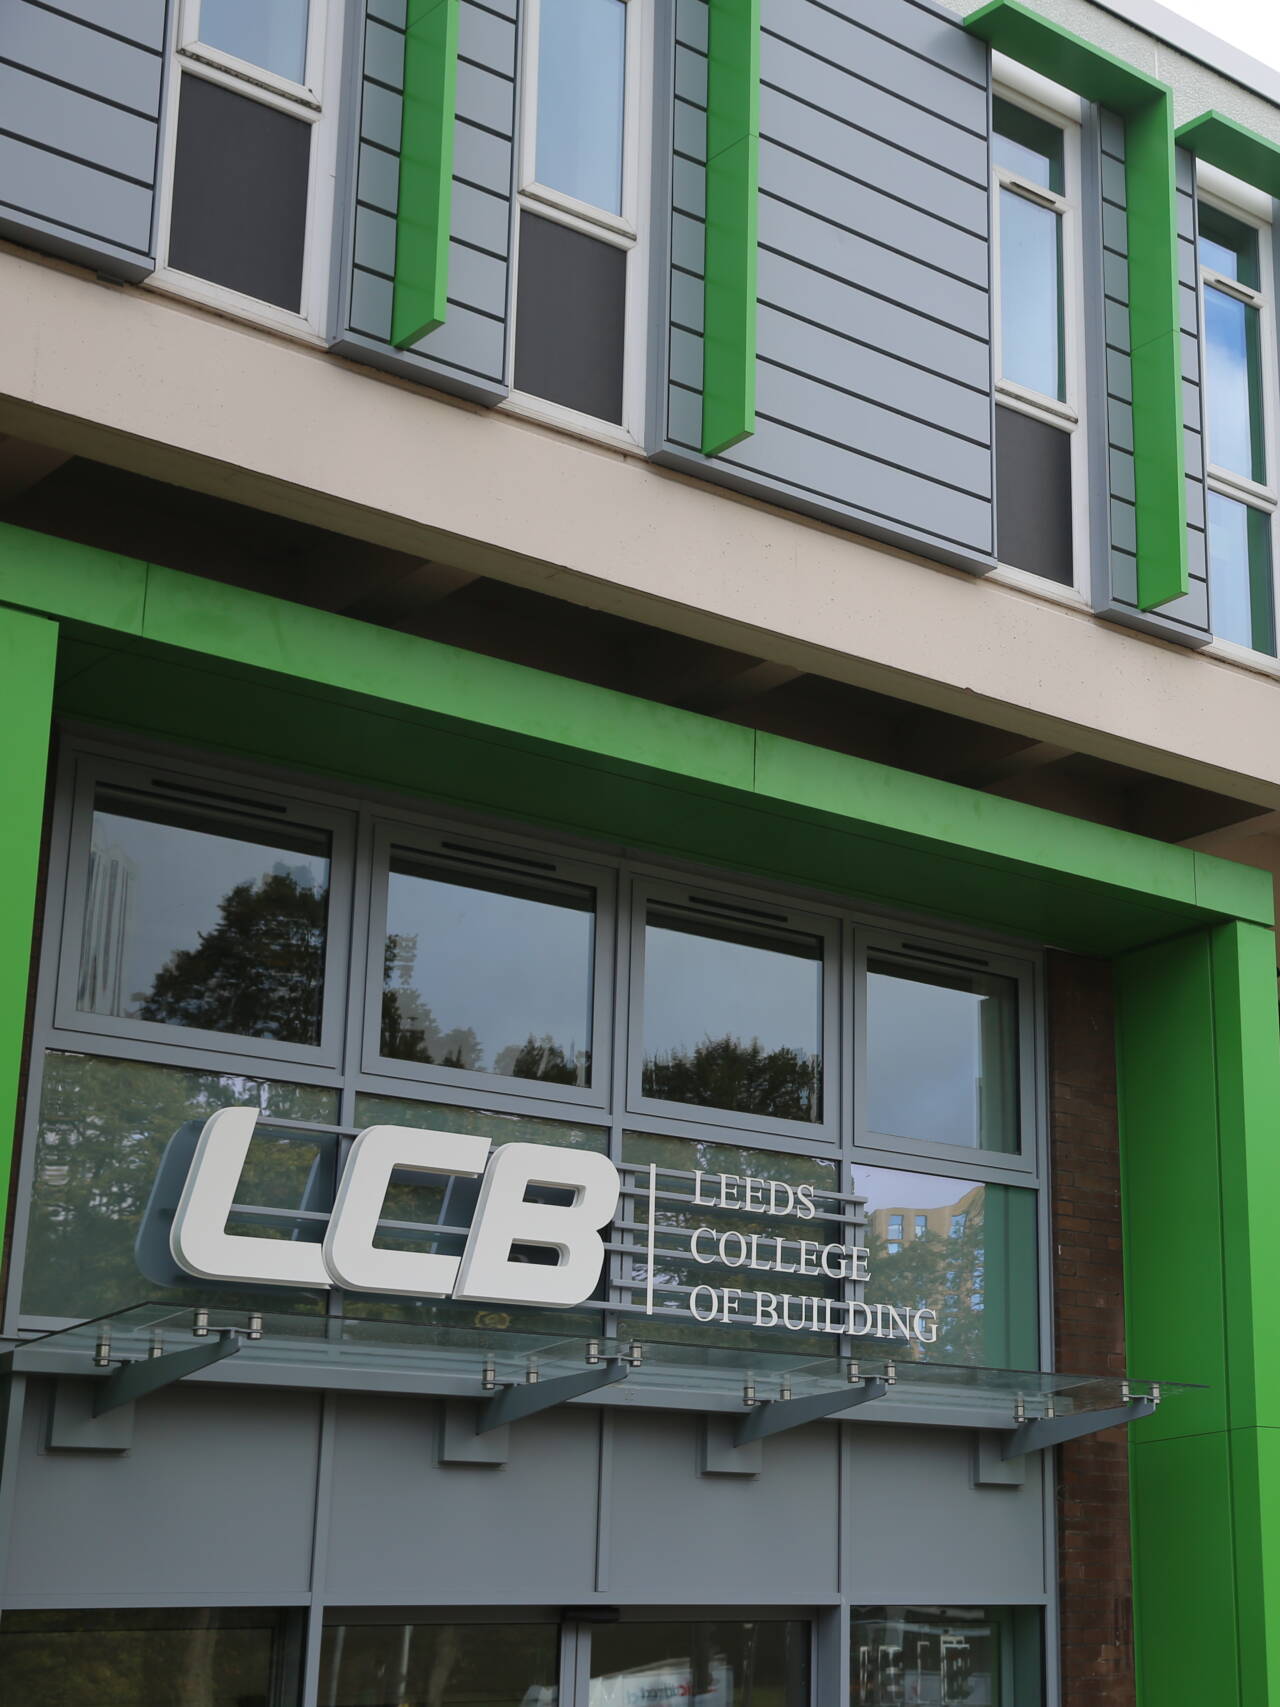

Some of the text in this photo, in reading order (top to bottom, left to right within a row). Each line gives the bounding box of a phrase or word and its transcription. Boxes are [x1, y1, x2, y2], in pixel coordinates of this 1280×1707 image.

[169, 1106, 621, 1309] LCB
[691, 1169, 817, 1220] LEEDS
[690, 1227, 872, 1282] COLLEGE
[689, 1284, 939, 1343] OF BUILDING
